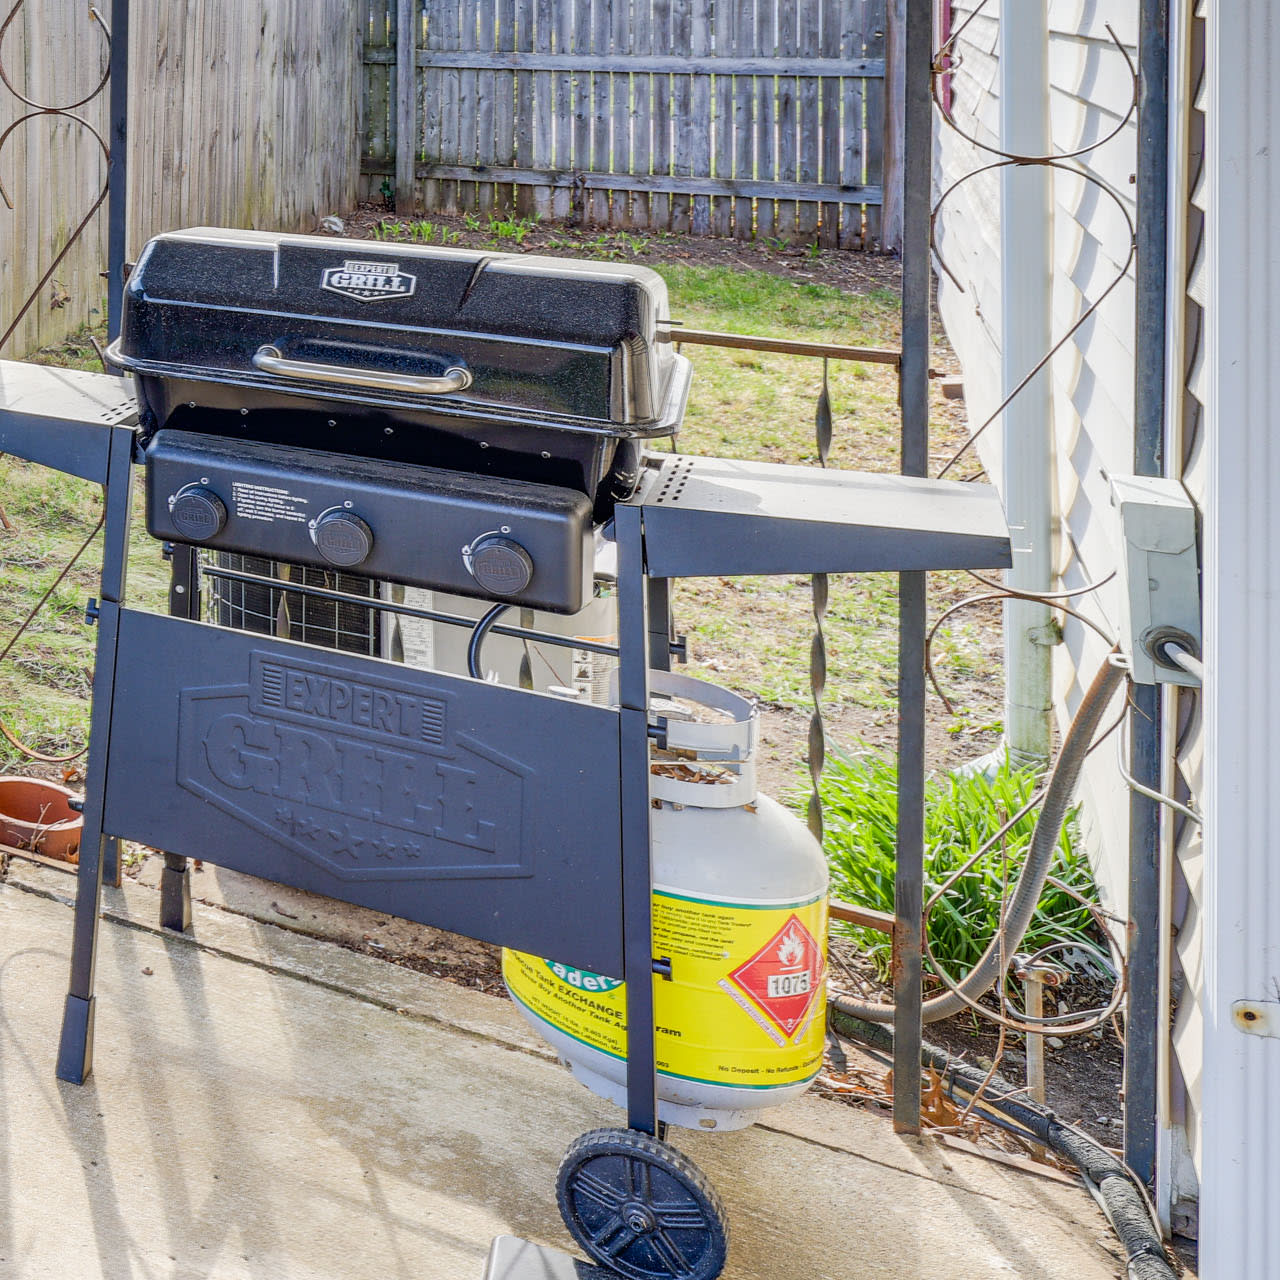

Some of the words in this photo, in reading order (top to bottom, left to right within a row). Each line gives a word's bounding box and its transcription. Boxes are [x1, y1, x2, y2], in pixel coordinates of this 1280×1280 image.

[330, 273, 406, 291] GRILL
[354, 265, 389, 274] EXPERT
[286, 671, 420, 735] EXPERT
[203, 714, 496, 854] GRILL
[771, 972, 809, 996] 1075
[558, 985, 624, 1020] EXCHANGE
